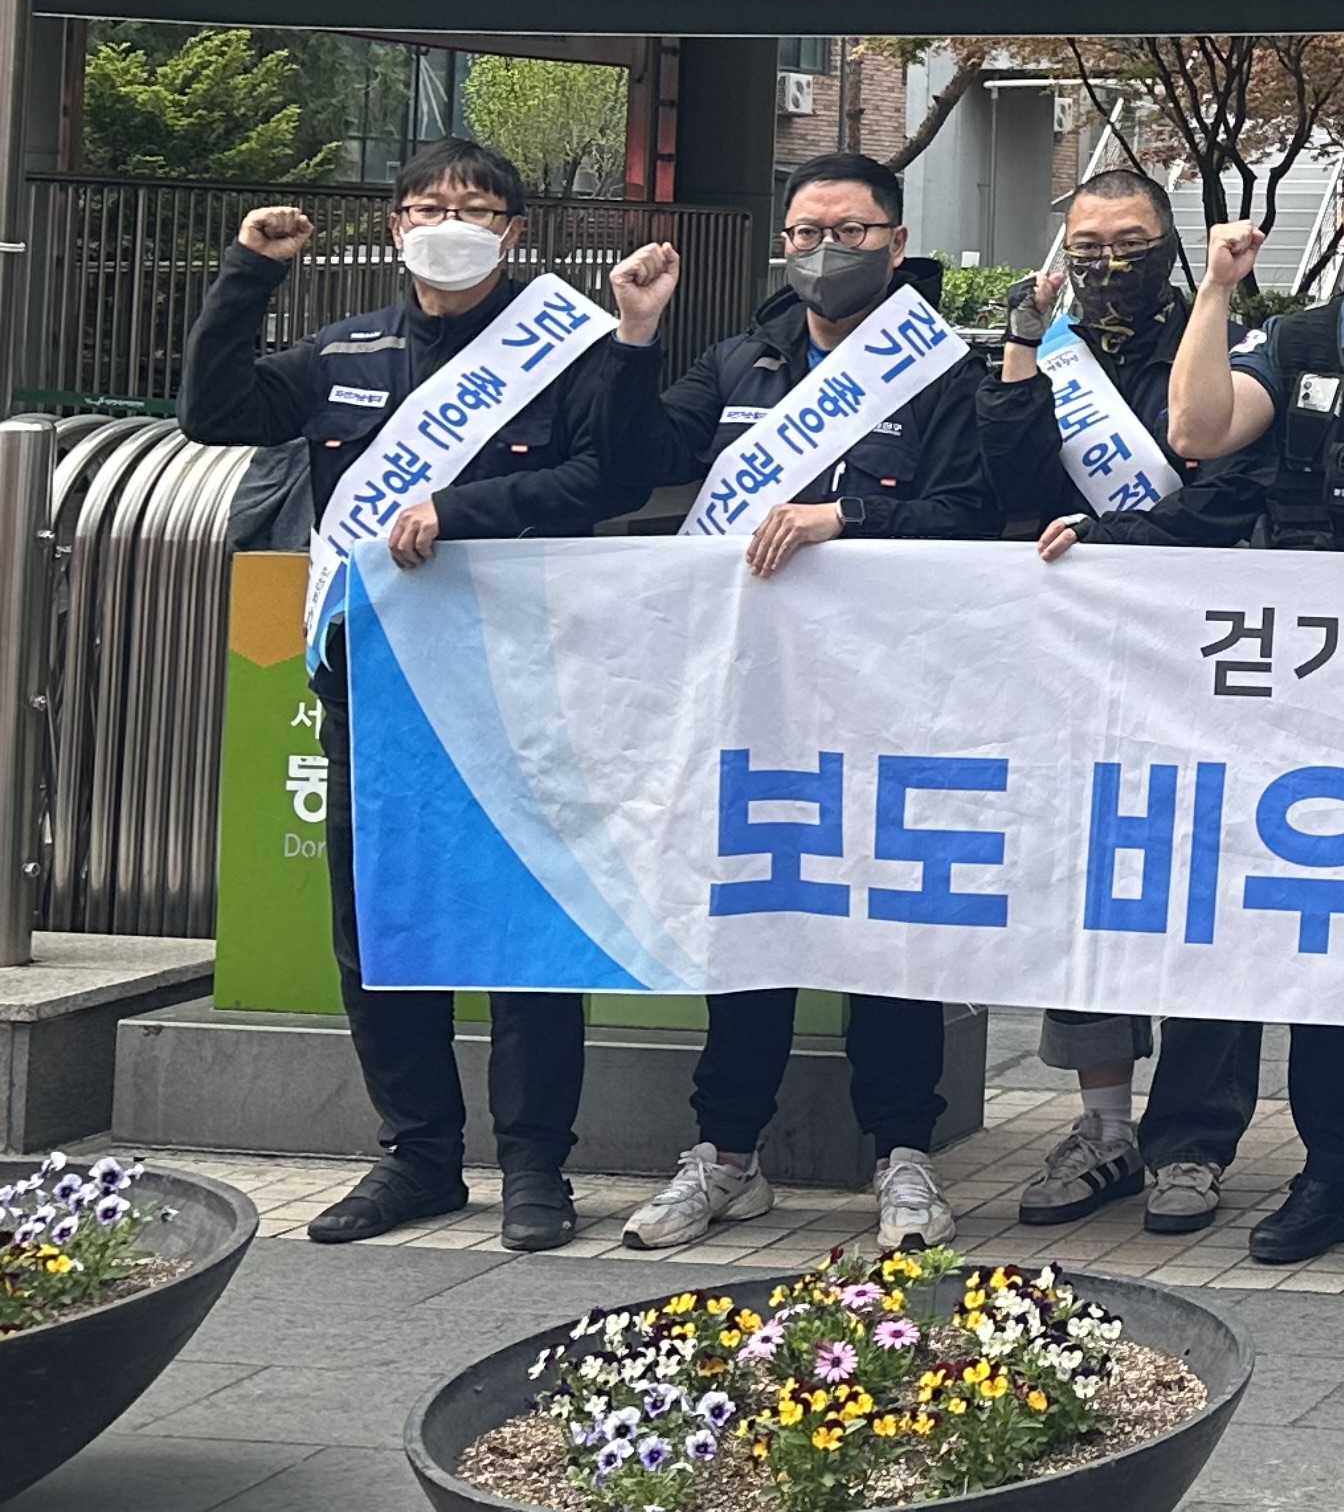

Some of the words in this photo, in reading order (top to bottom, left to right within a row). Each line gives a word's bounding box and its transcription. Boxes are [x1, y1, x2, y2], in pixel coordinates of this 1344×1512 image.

[501, 291, 591, 371] 걷기
[863, 301, 949, 384] 걷기
[417, 365, 507, 449] 좋은
[775, 370, 866, 455] 좋은
[683, 442, 784, 535] 광진
[1082, 433, 1132, 477] 위
[708, 748, 1009, 927] 보도
